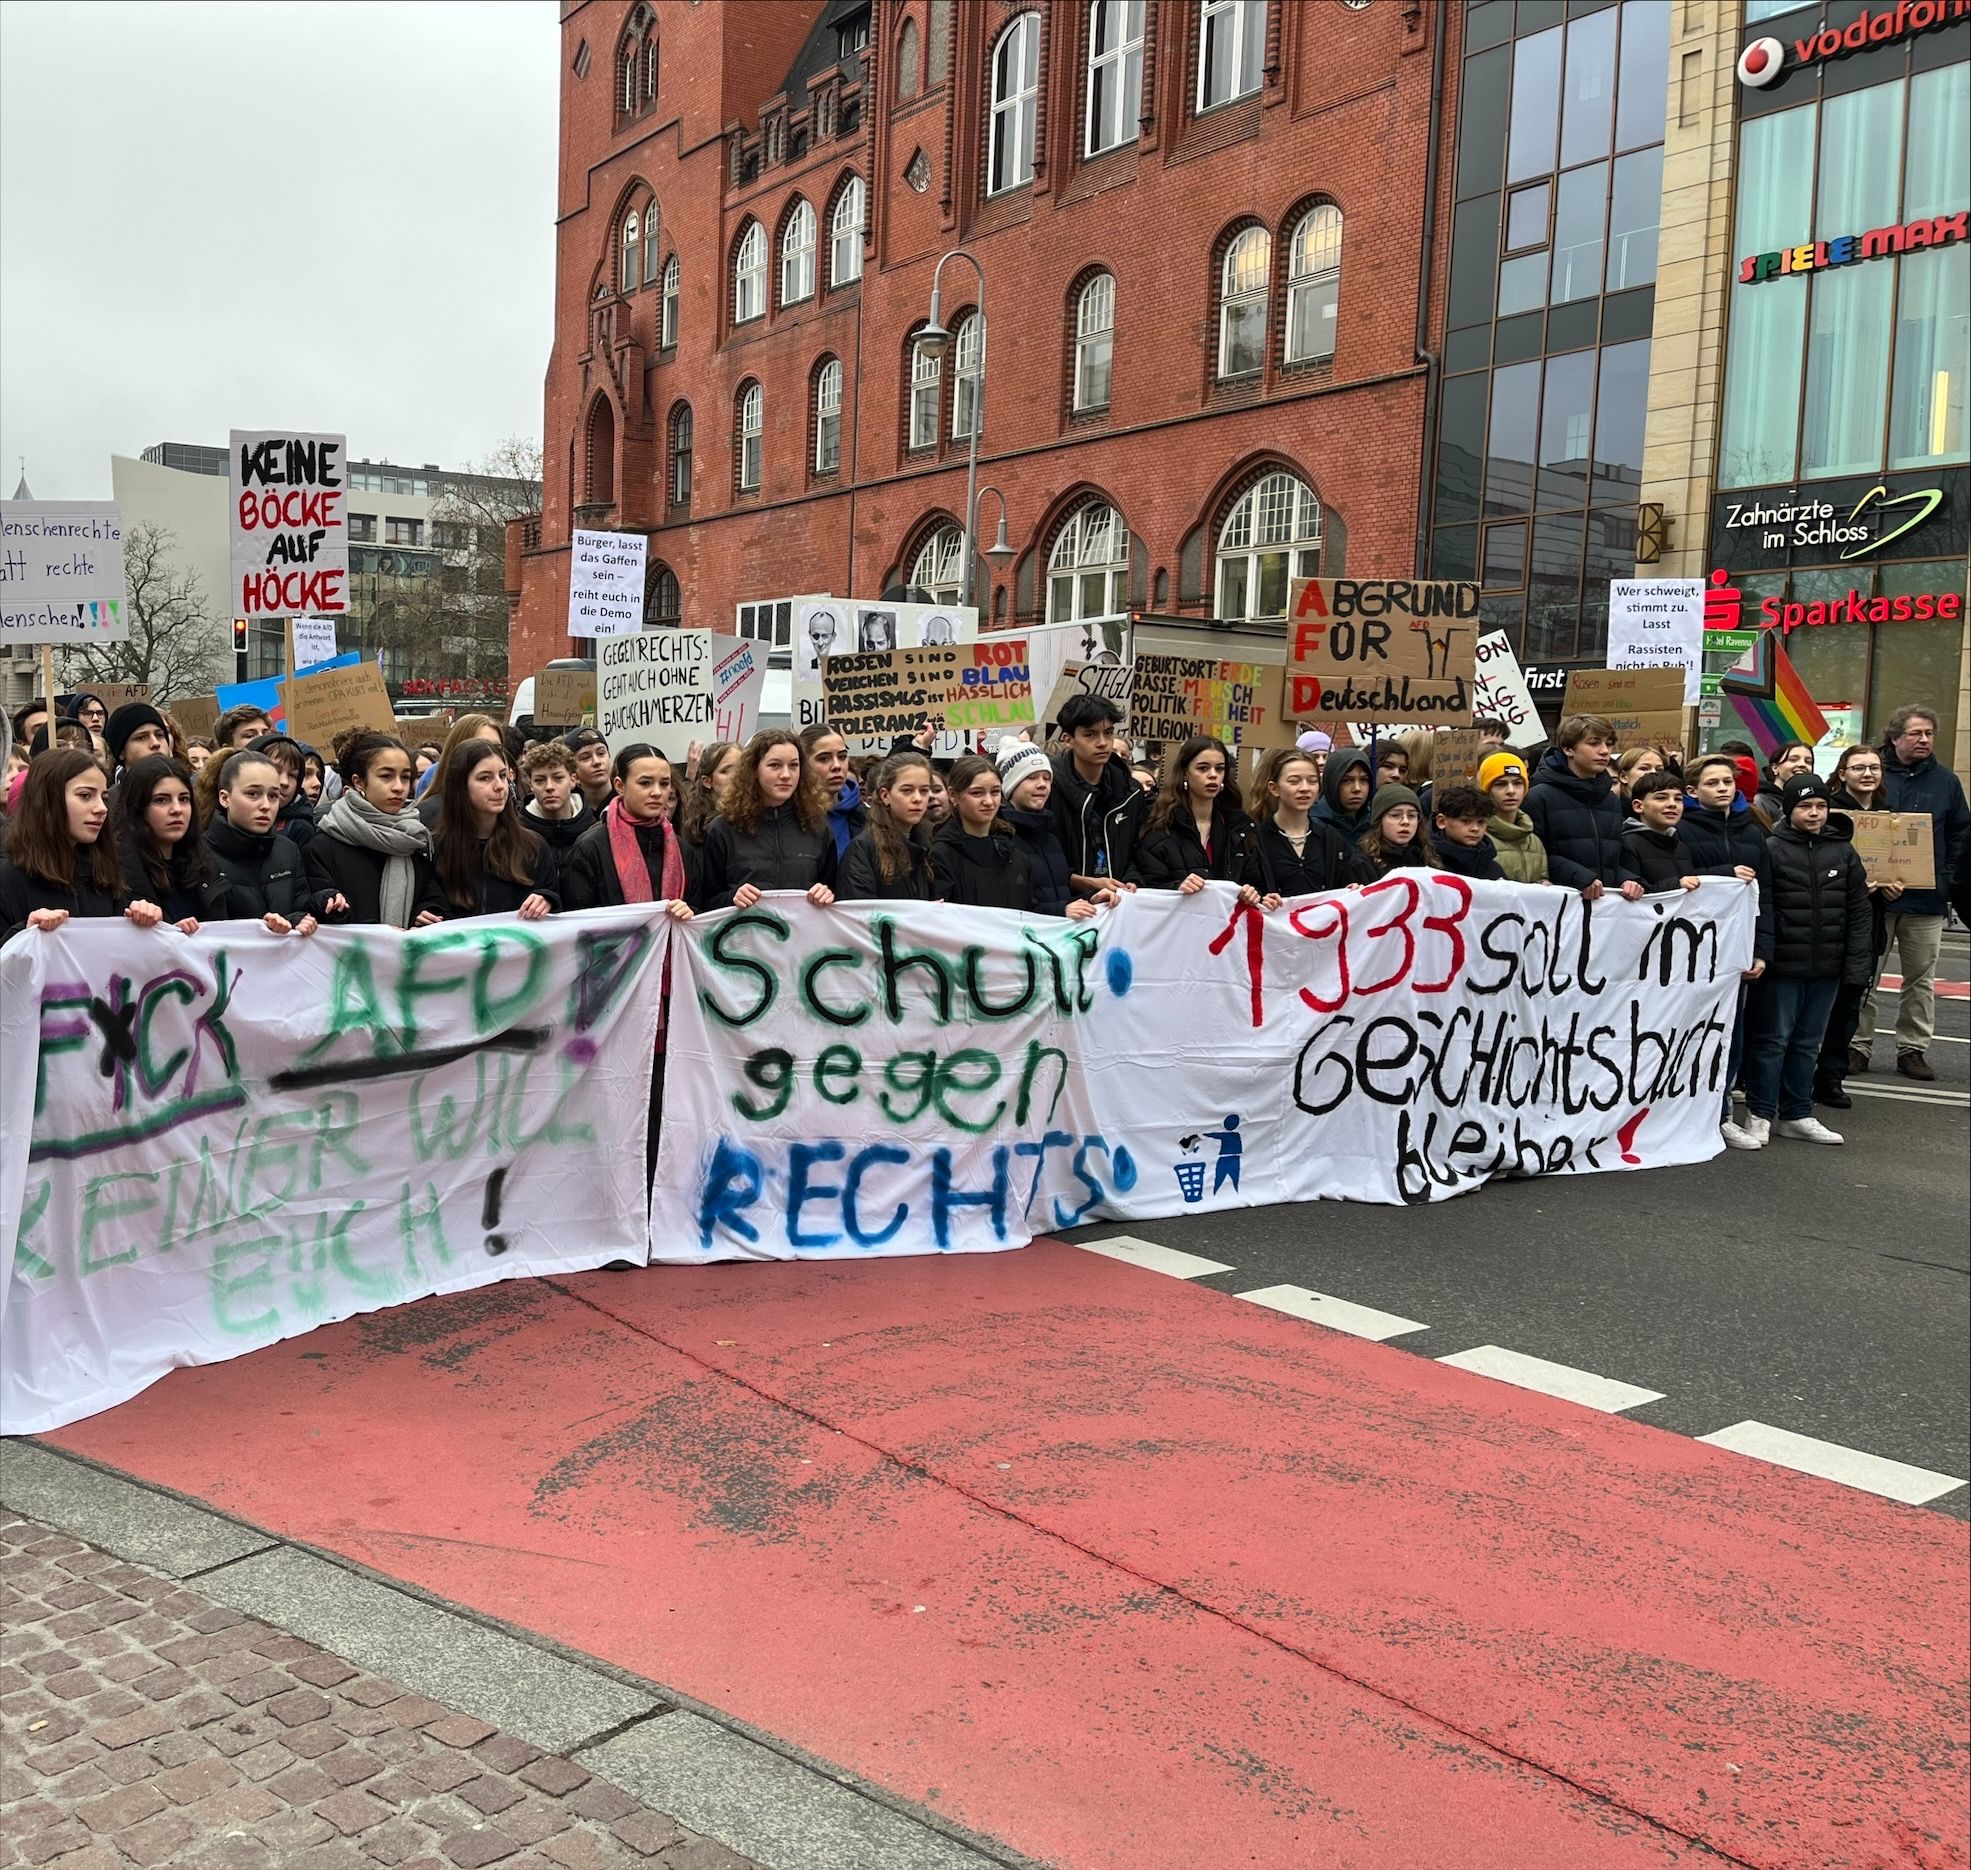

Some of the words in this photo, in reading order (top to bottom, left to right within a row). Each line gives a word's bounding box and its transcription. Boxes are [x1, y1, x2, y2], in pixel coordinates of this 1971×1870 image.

[1794, 0, 1971, 62] vodafon
[1739, 235, 1856, 283] SPIELE
[1861, 211, 1971, 258] MAX
[241, 440, 341, 487] KEINE
[239, 489, 342, 530] BÖCKE
[1725, 501, 1834, 529] Zahnärzte
[0, 517, 121, 540] enschenrechte
[1763, 530, 1785, 550] im
[1793, 523, 1868, 547] Schloss
[266, 530, 326, 565] AUF
[577, 536, 615, 550] Bürger,
[619, 539, 643, 551] lasst
[0, 550, 27, 581] att
[46, 553, 95, 577] rechte
[580, 553, 599, 563] das
[602, 554, 637, 567] Gaffen
[593, 570, 614, 580] sein
[243, 567, 345, 613] HÖCKE
[573, 590, 599, 600] reiht
[602, 593, 627, 602] euch
[631, 594, 640, 603] in
[1296, 580, 1480, 618] ABGRUND
[1617, 586, 1641, 596] Wer
[1645, 585, 1699, 598] schweigt,
[580, 606, 597, 616] die
[600, 608, 632, 619] Demo
[1627, 603, 1667, 612] stimmt
[1671, 604, 1688, 612] zu.
[1760, 589, 1962, 636] Sparkasse
[595, 623, 615, 633] ein!
[1409, 620, 1430, 629] AFD
[1643, 619, 1671, 629] Lasst
[603, 639, 636, 666] GEGEN
[636, 634, 709, 663] RECHTS:
[1628, 644, 1682, 654] Rassisten
[1726, 636, 1752, 647] Ravenna
[826, 653, 892, 675] ROSEN
[905, 652, 956, 665] SIND
[973, 640, 1027, 667] ROT
[1135, 655, 1218, 679] GEBURTSORT:
[1219, 661, 1263, 688] ERDE
[1616, 661, 1645, 670] nicht
[1649, 661, 1659, 669] in
[125, 684, 148, 697] AFD
[603, 673, 628, 700] GEHT
[628, 669, 656, 693] AUCH
[659, 667, 700, 687] OHNE
[823, 672, 898, 692] VEILCHEN
[908, 670, 954, 684] SIND
[962, 665, 1030, 685] BLAU
[1133, 673, 1182, 694] RASSE:
[1183, 678, 1253, 705] MENSCH
[1524, 667, 1565, 689] First
[1572, 673, 1600, 690] Rosen
[828, 689, 928, 715] RASSISMUS
[1131, 693, 1191, 715] POLITIK:
[1193, 698, 1266, 725] FREIHEIT
[1291, 675, 1468, 714] Deutschland
[604, 692, 714, 737] BAUCHSCHMERZEN
[828, 711, 928, 736] TOLERANZ
[947, 702, 1035, 727] SCHLAU
[1130, 716, 1198, 741] RELIGION:
[1857, 817, 1879, 829] AFD
[1208, 874, 1473, 1028] 1933
[1466, 893, 1607, 999] soll
[1638, 903, 1718, 987] im
[296, 925, 552, 1065] AFD
[732, 1040, 1068, 1132] gegen
[405, 1048, 598, 1163] WILL
[699, 1132, 1110, 1250] RECHTS
